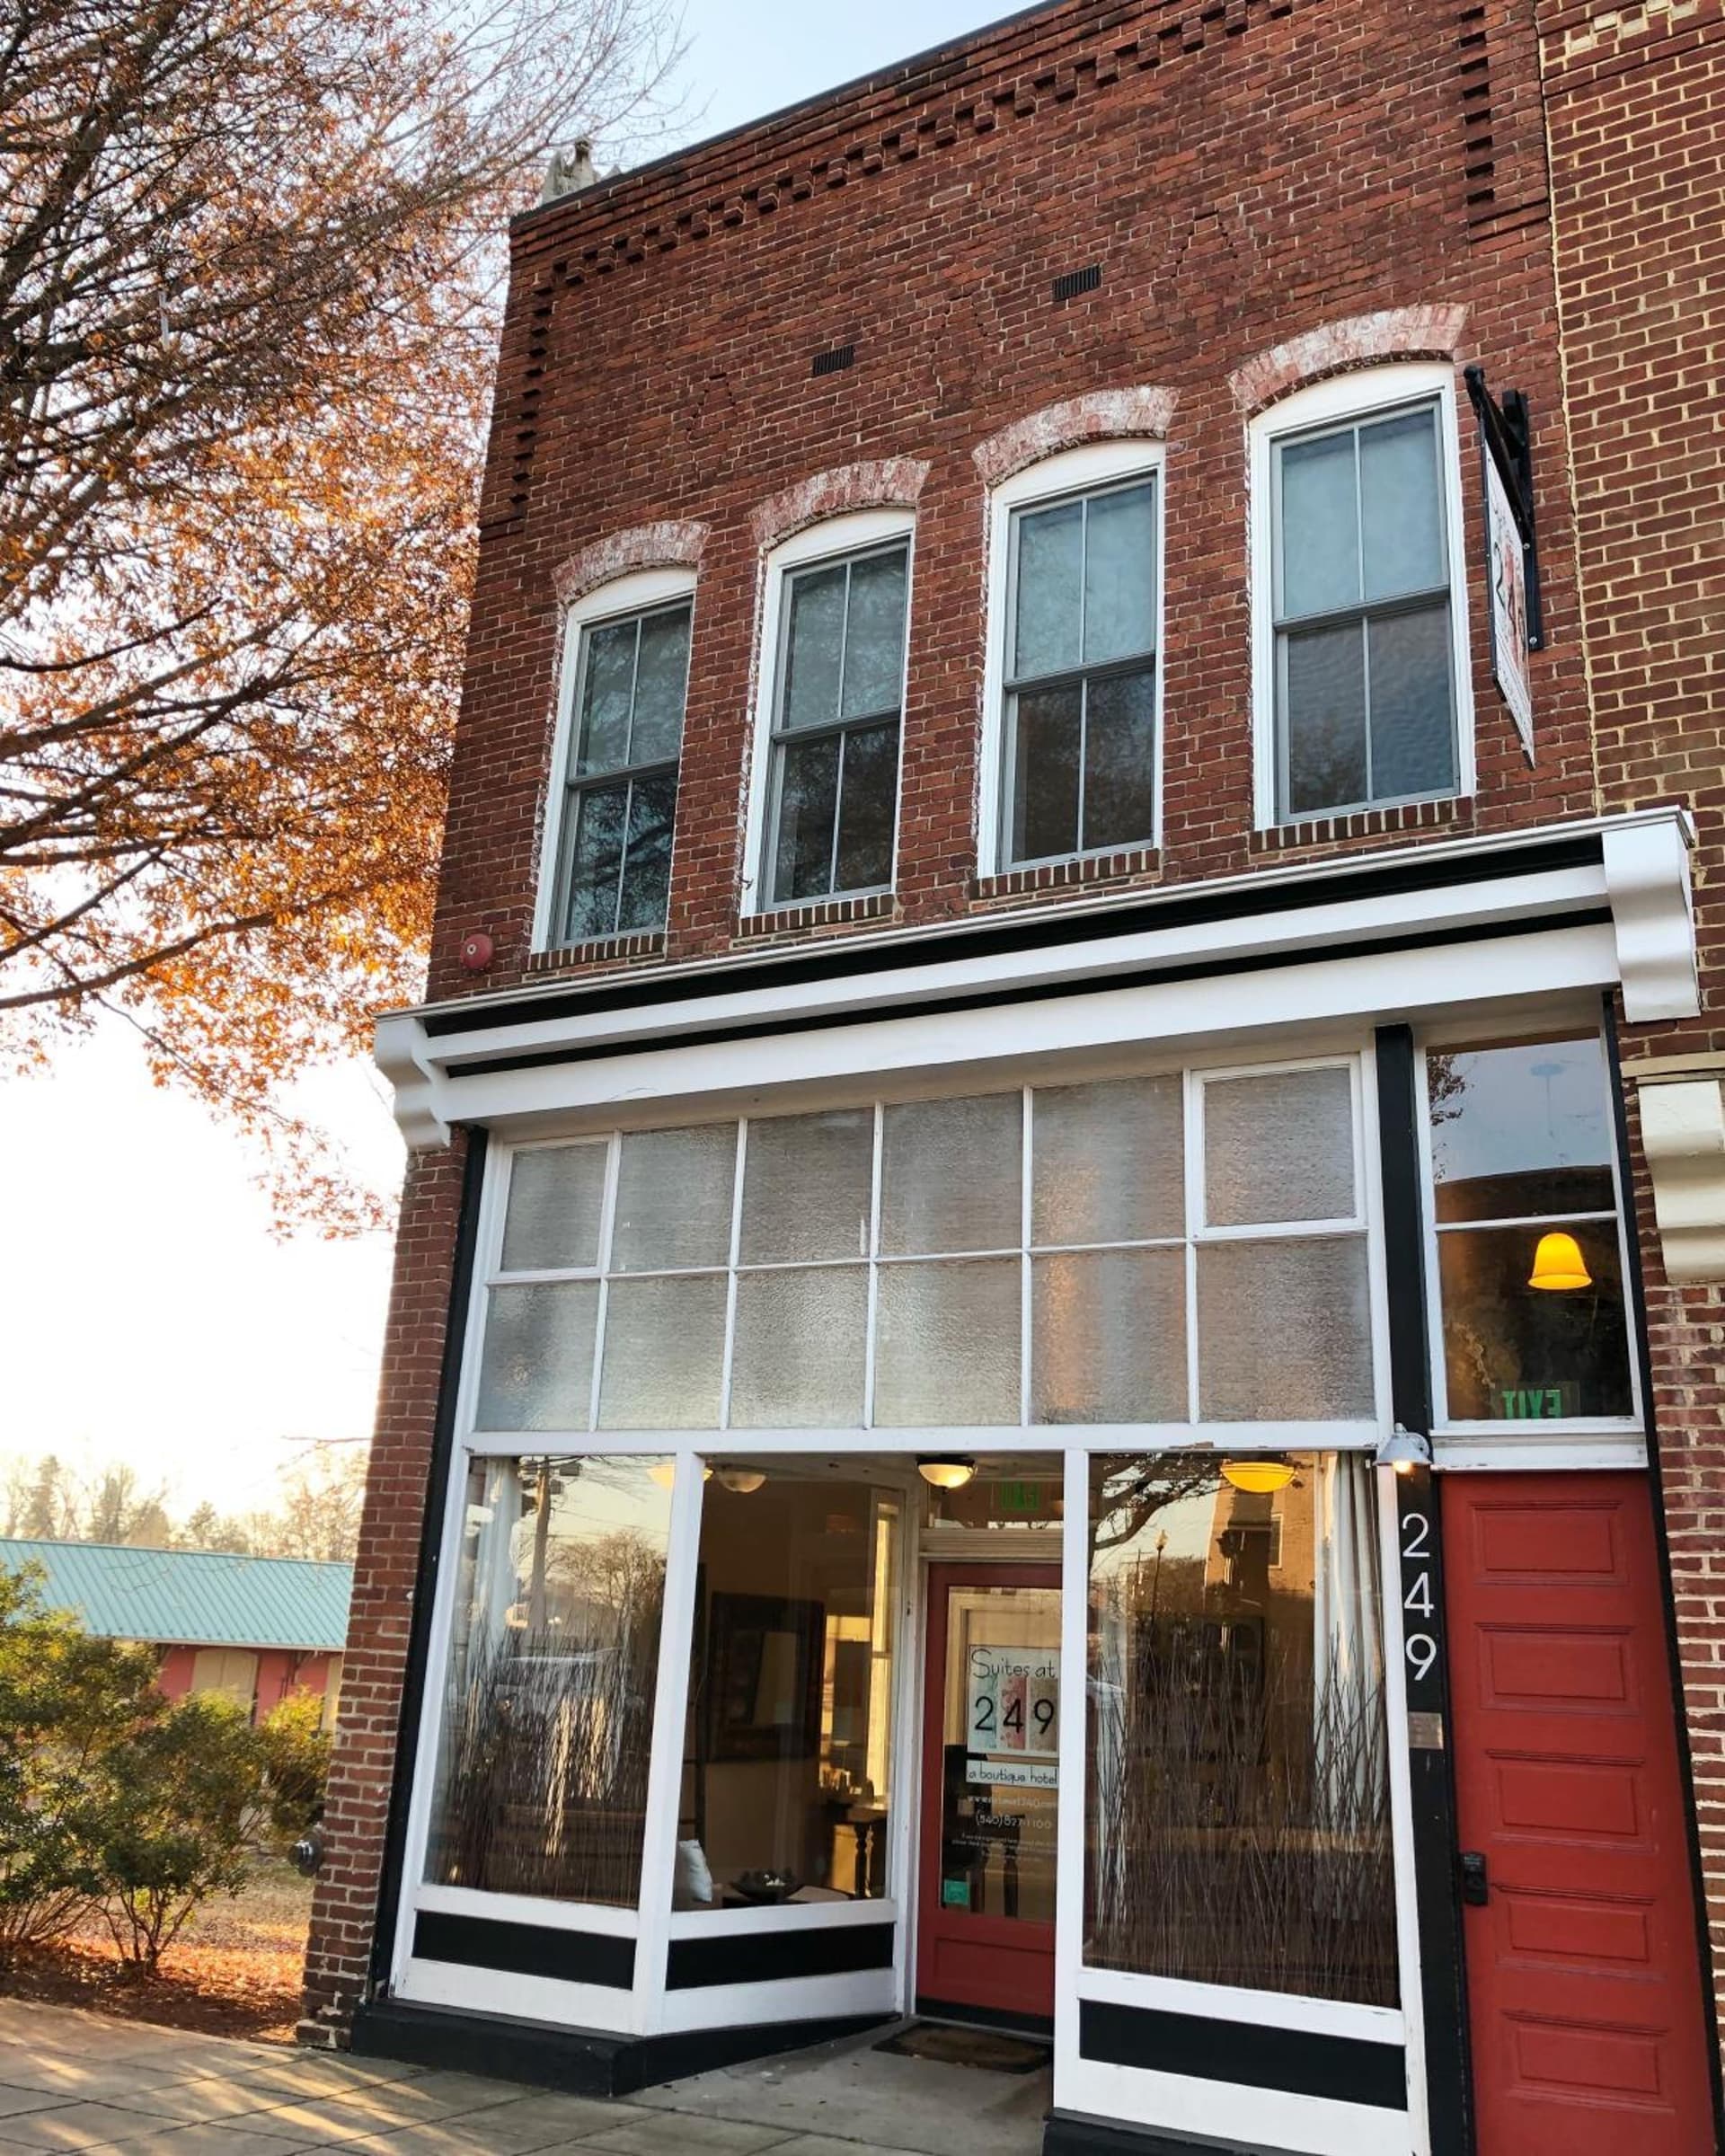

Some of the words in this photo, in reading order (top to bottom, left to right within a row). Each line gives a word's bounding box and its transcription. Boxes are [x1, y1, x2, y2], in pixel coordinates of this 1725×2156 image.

[1402, 1513, 1437, 1681] 249
[971, 1648, 1031, 1680] Suites
[1034, 1660, 1057, 1678] at
[974, 1695, 1055, 1735] 249
[969, 1770, 977, 1779] a
[979, 1762, 1026, 1783] boutique
[1030, 1766, 1057, 1784] hotel
